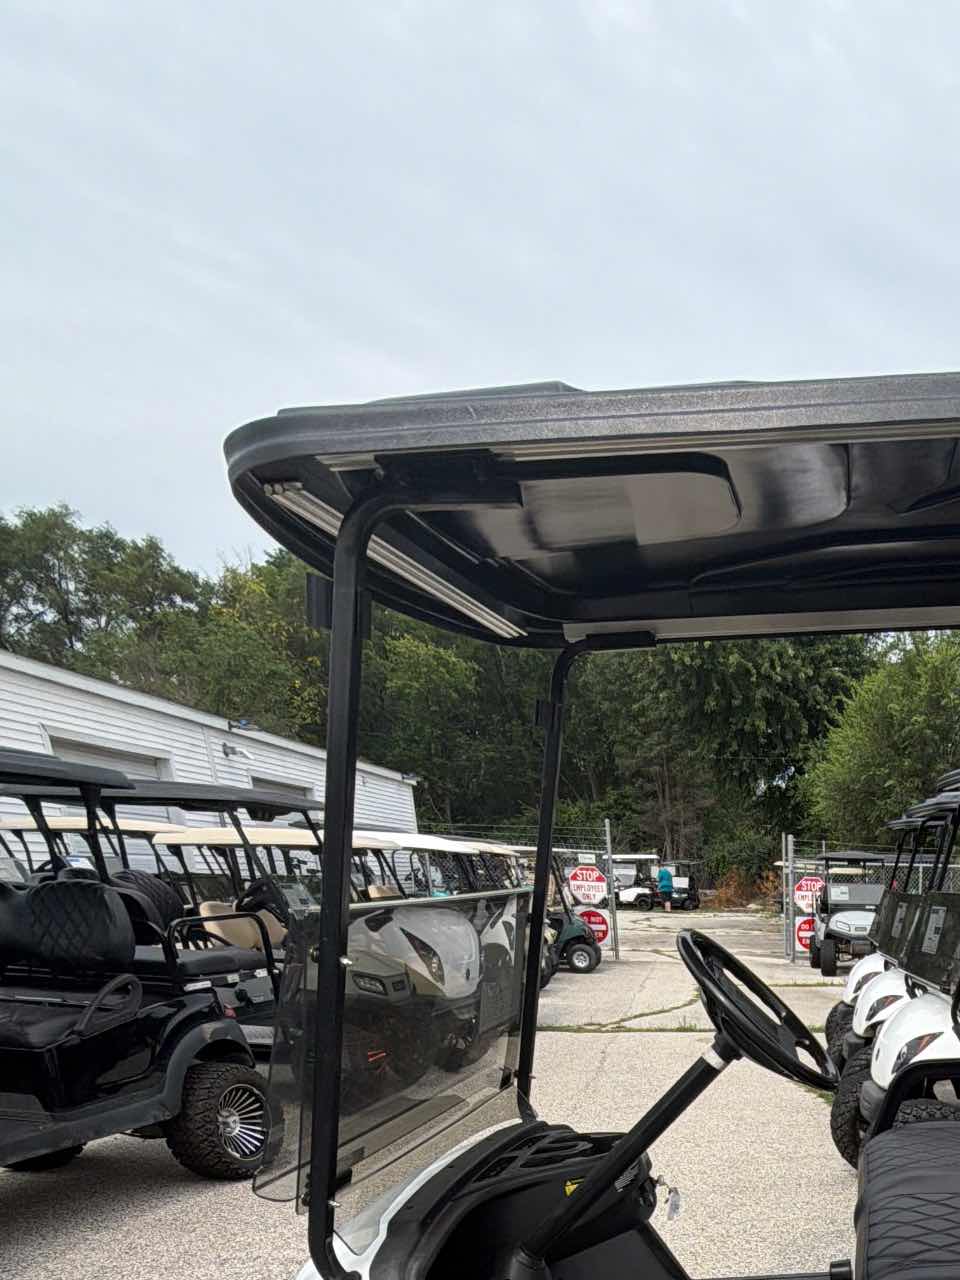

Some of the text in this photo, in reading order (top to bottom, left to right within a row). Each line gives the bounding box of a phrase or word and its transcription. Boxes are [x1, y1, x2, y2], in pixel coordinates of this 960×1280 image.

[576, 870, 599, 881] STOP
[573, 884, 604, 893] EMPLOYEES
[801, 881, 821, 891] STOP
[582, 893, 596, 901] ONLY
